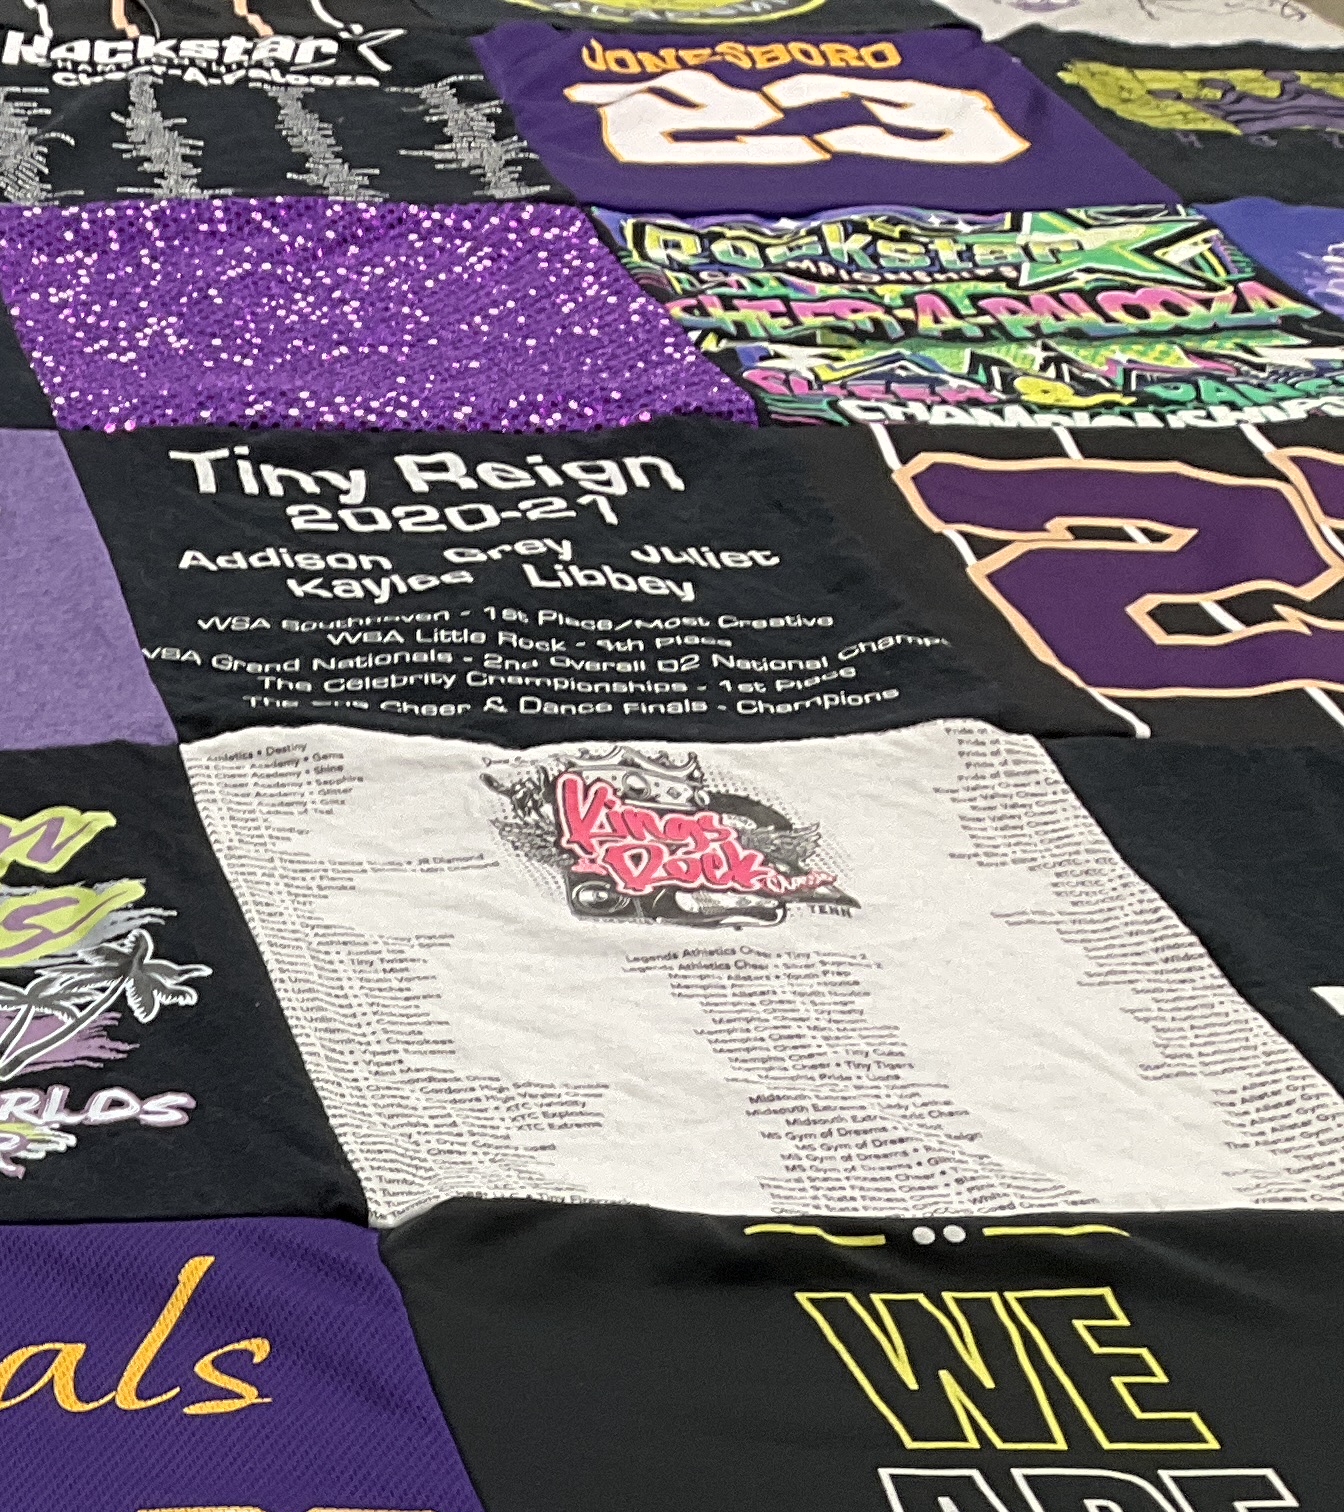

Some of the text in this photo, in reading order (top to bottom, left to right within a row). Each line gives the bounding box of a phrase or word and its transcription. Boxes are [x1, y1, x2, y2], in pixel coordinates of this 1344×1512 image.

[582, 38, 904, 75] JONESBORO
[563, 69, 1032, 165] 23
[645, 220, 1084, 270] Rockstar
[168, 445, 686, 505] Tiny Reign
[285, 494, 619, 533] 2020-21
[178, 537, 781, 572] Addison Grey Juliet
[286, 563, 696, 604] Kaylee Libbey
[197, 615, 271, 631] WSA
[483, 605, 530, 622] 1st
[717, 614, 835, 630] Creative
[326, 630, 405, 646] WSA
[416, 628, 487, 645] Little
[497, 631, 567, 652] Rock
[655, 633, 733, 650] Place
[211, 653, 301, 672] Grand
[312, 649, 453, 672] Nationals
[657, 654, 701, 672] D2
[712, 652, 829, 672] National
[257, 664, 857, 695] The Celebrity Championships 1st Place
[242, 695, 299, 708] The
[379, 699, 471, 717] Cheer
[518, 697, 613, 715] Dance
[623, 699, 708, 715] Finals
[736, 686, 900, 715] Champions
[794, 1286, 1221, 1450] WE
